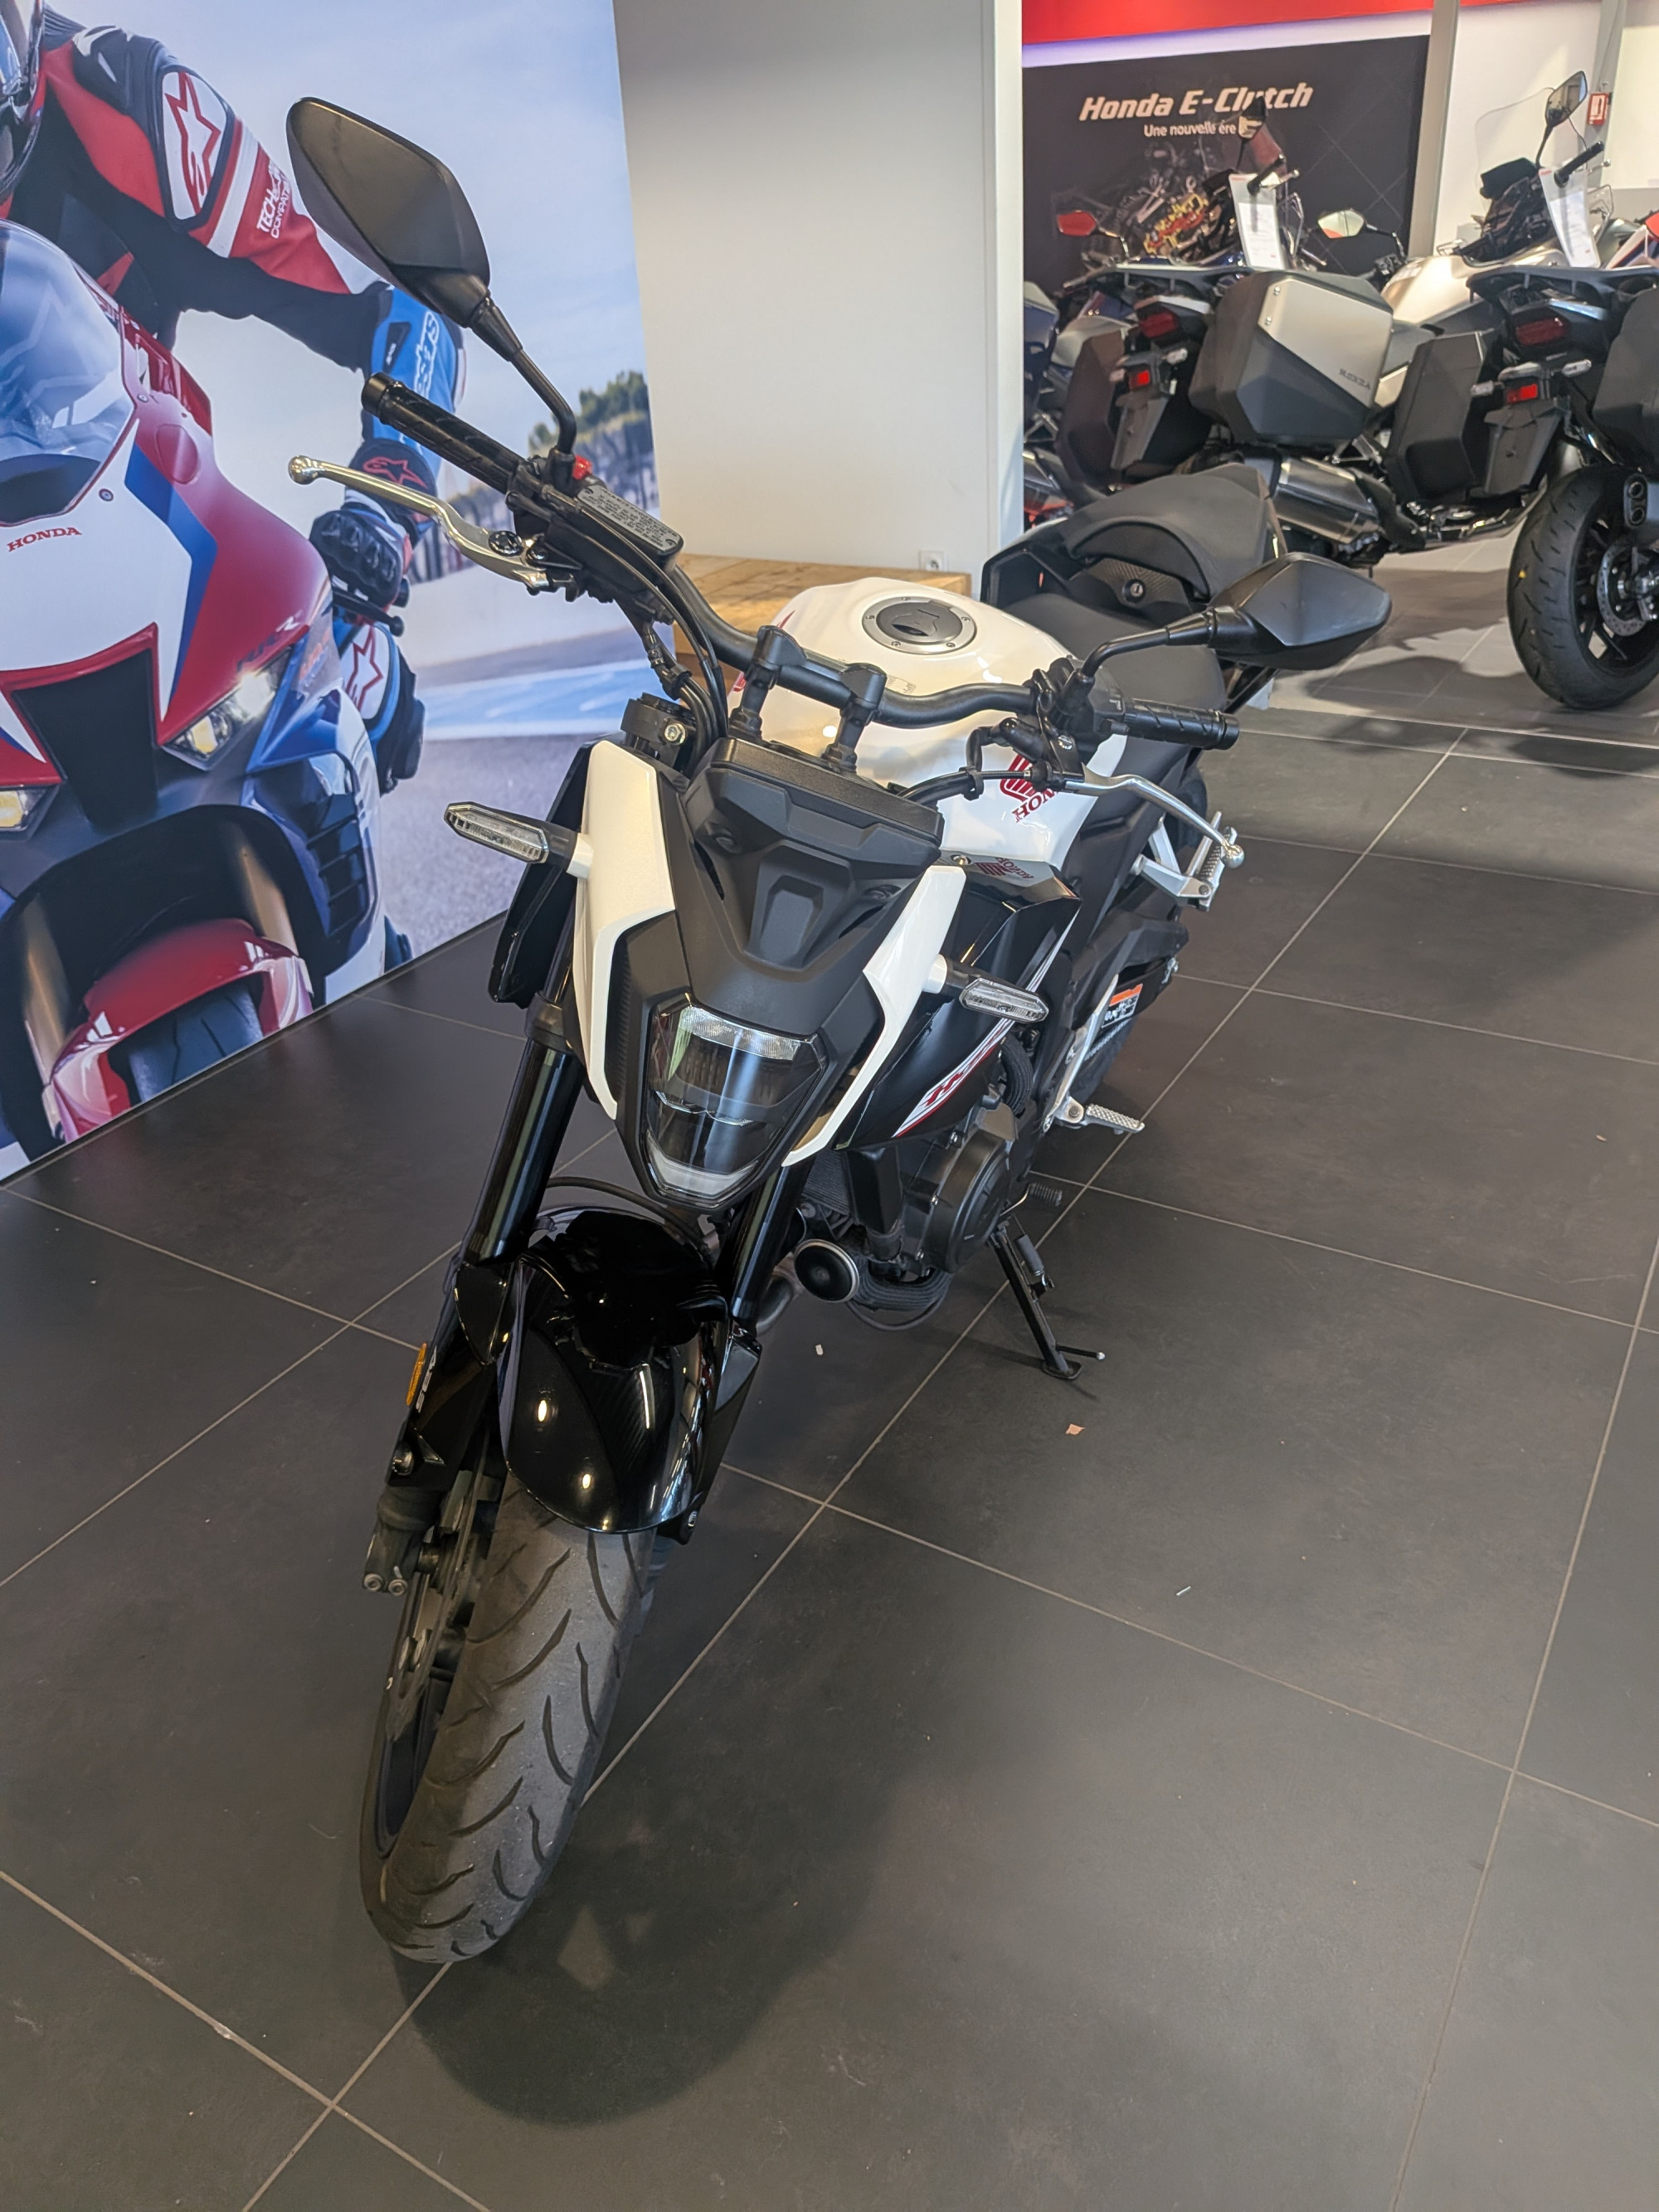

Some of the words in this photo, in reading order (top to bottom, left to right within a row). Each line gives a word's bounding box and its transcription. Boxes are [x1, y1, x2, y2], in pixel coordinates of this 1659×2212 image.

[1078, 92, 1174, 121] Honda
[1143, 124, 1168, 138] Une
[1170, 120, 1216, 136] nouvelle
[7, 527, 83, 552] HONDA
[1011, 788, 1057, 823] HON
[416, 1345, 437, 1413] ABS
